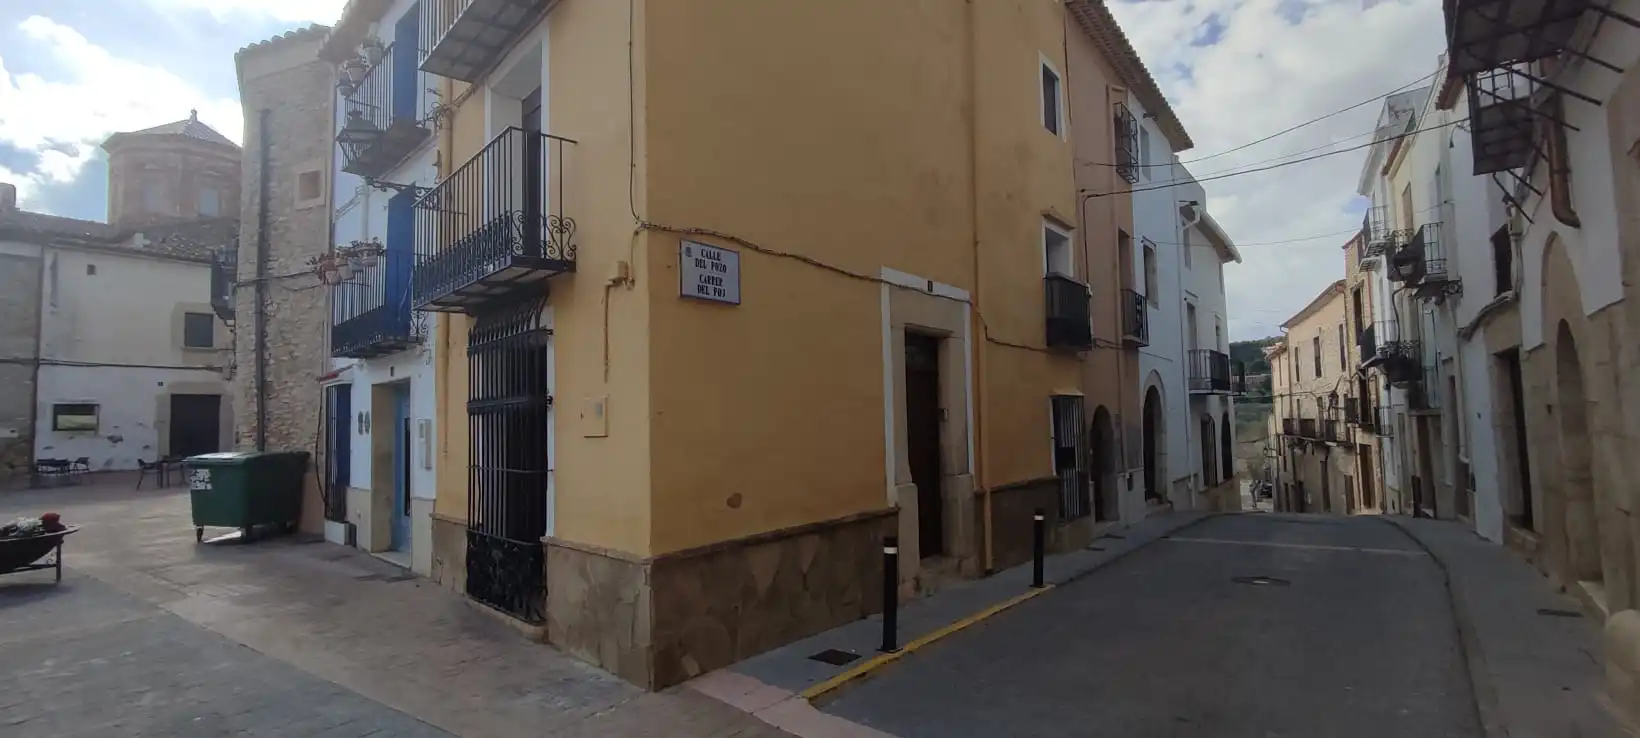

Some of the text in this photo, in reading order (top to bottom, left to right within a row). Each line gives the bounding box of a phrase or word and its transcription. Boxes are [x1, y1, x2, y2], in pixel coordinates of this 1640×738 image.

[701, 249, 721, 261] CALLE
[695, 258, 727, 273] DEL POZO
[699, 274, 723, 286] CARRER
[697, 284, 710, 296] DEL
